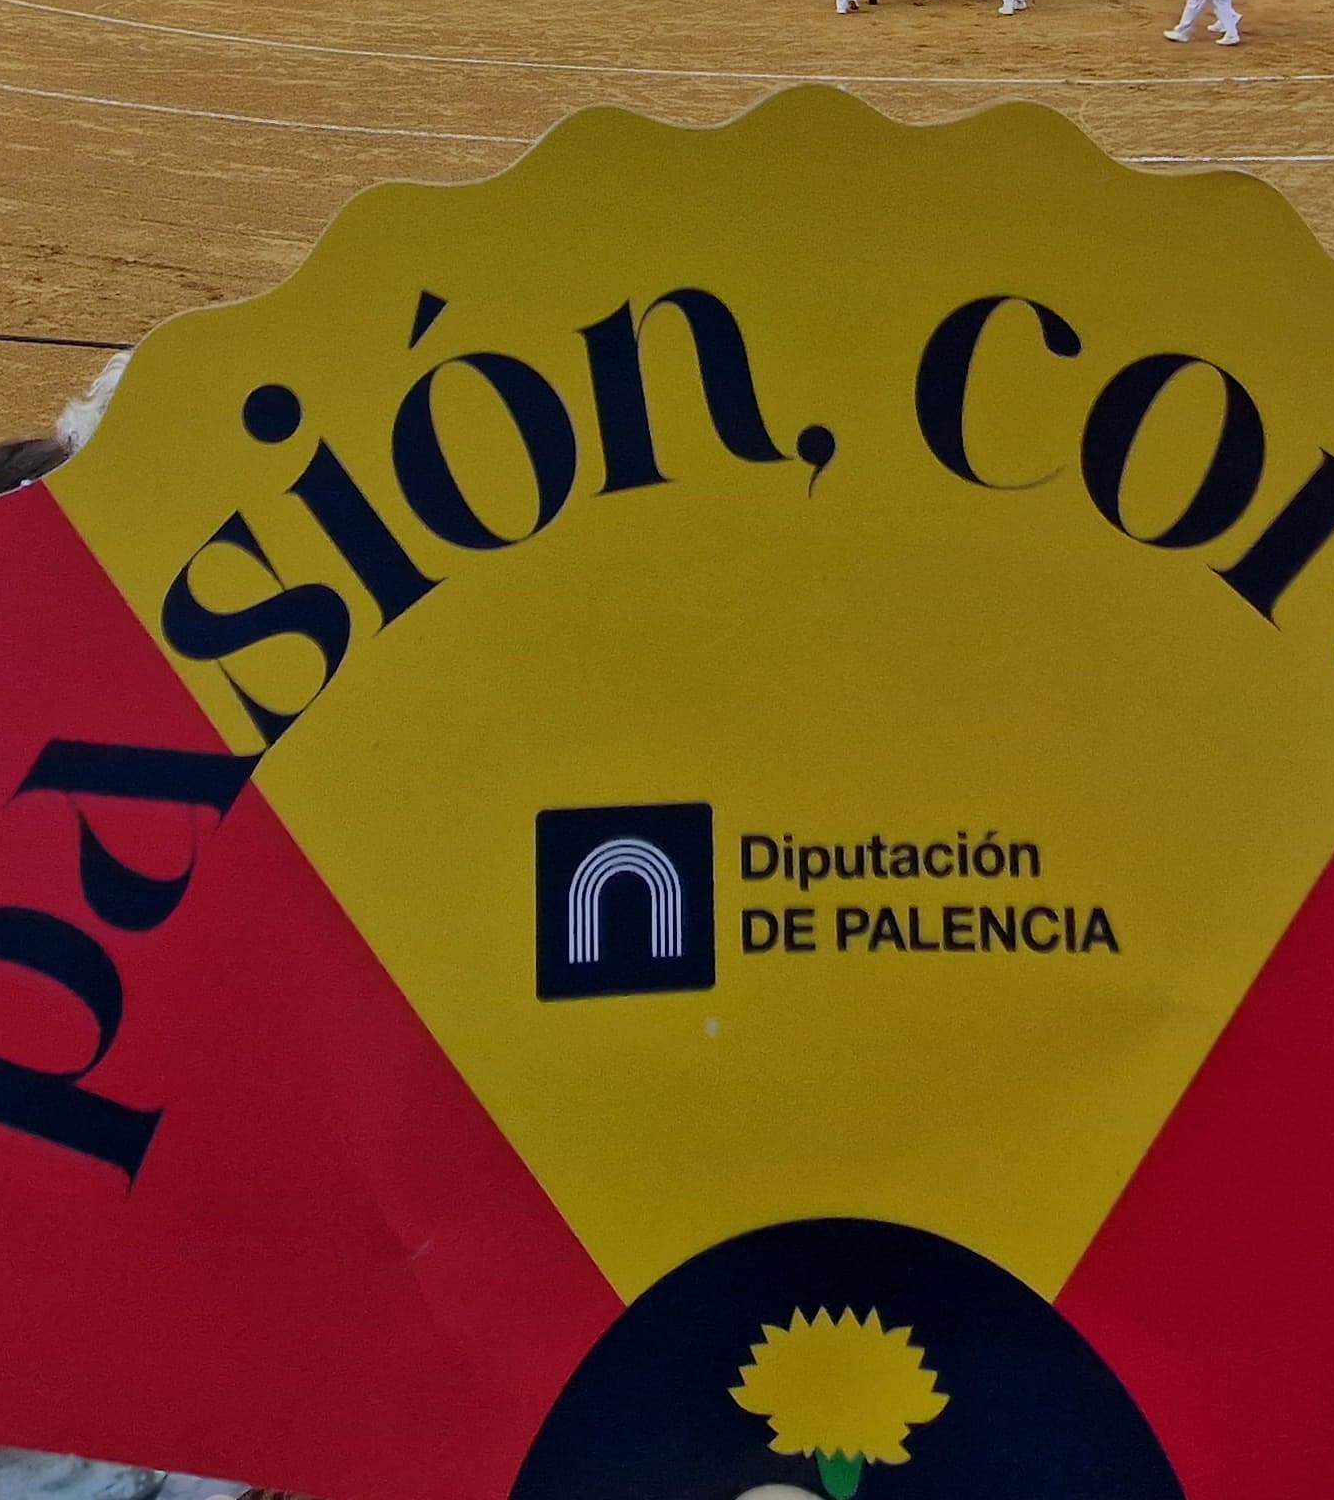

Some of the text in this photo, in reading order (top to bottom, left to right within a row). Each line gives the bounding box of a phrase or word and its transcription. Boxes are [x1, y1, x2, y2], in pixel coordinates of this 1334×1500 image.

[740, 830, 1042, 891] Diputación
[740, 905, 1120, 954] DE PALENCIA
